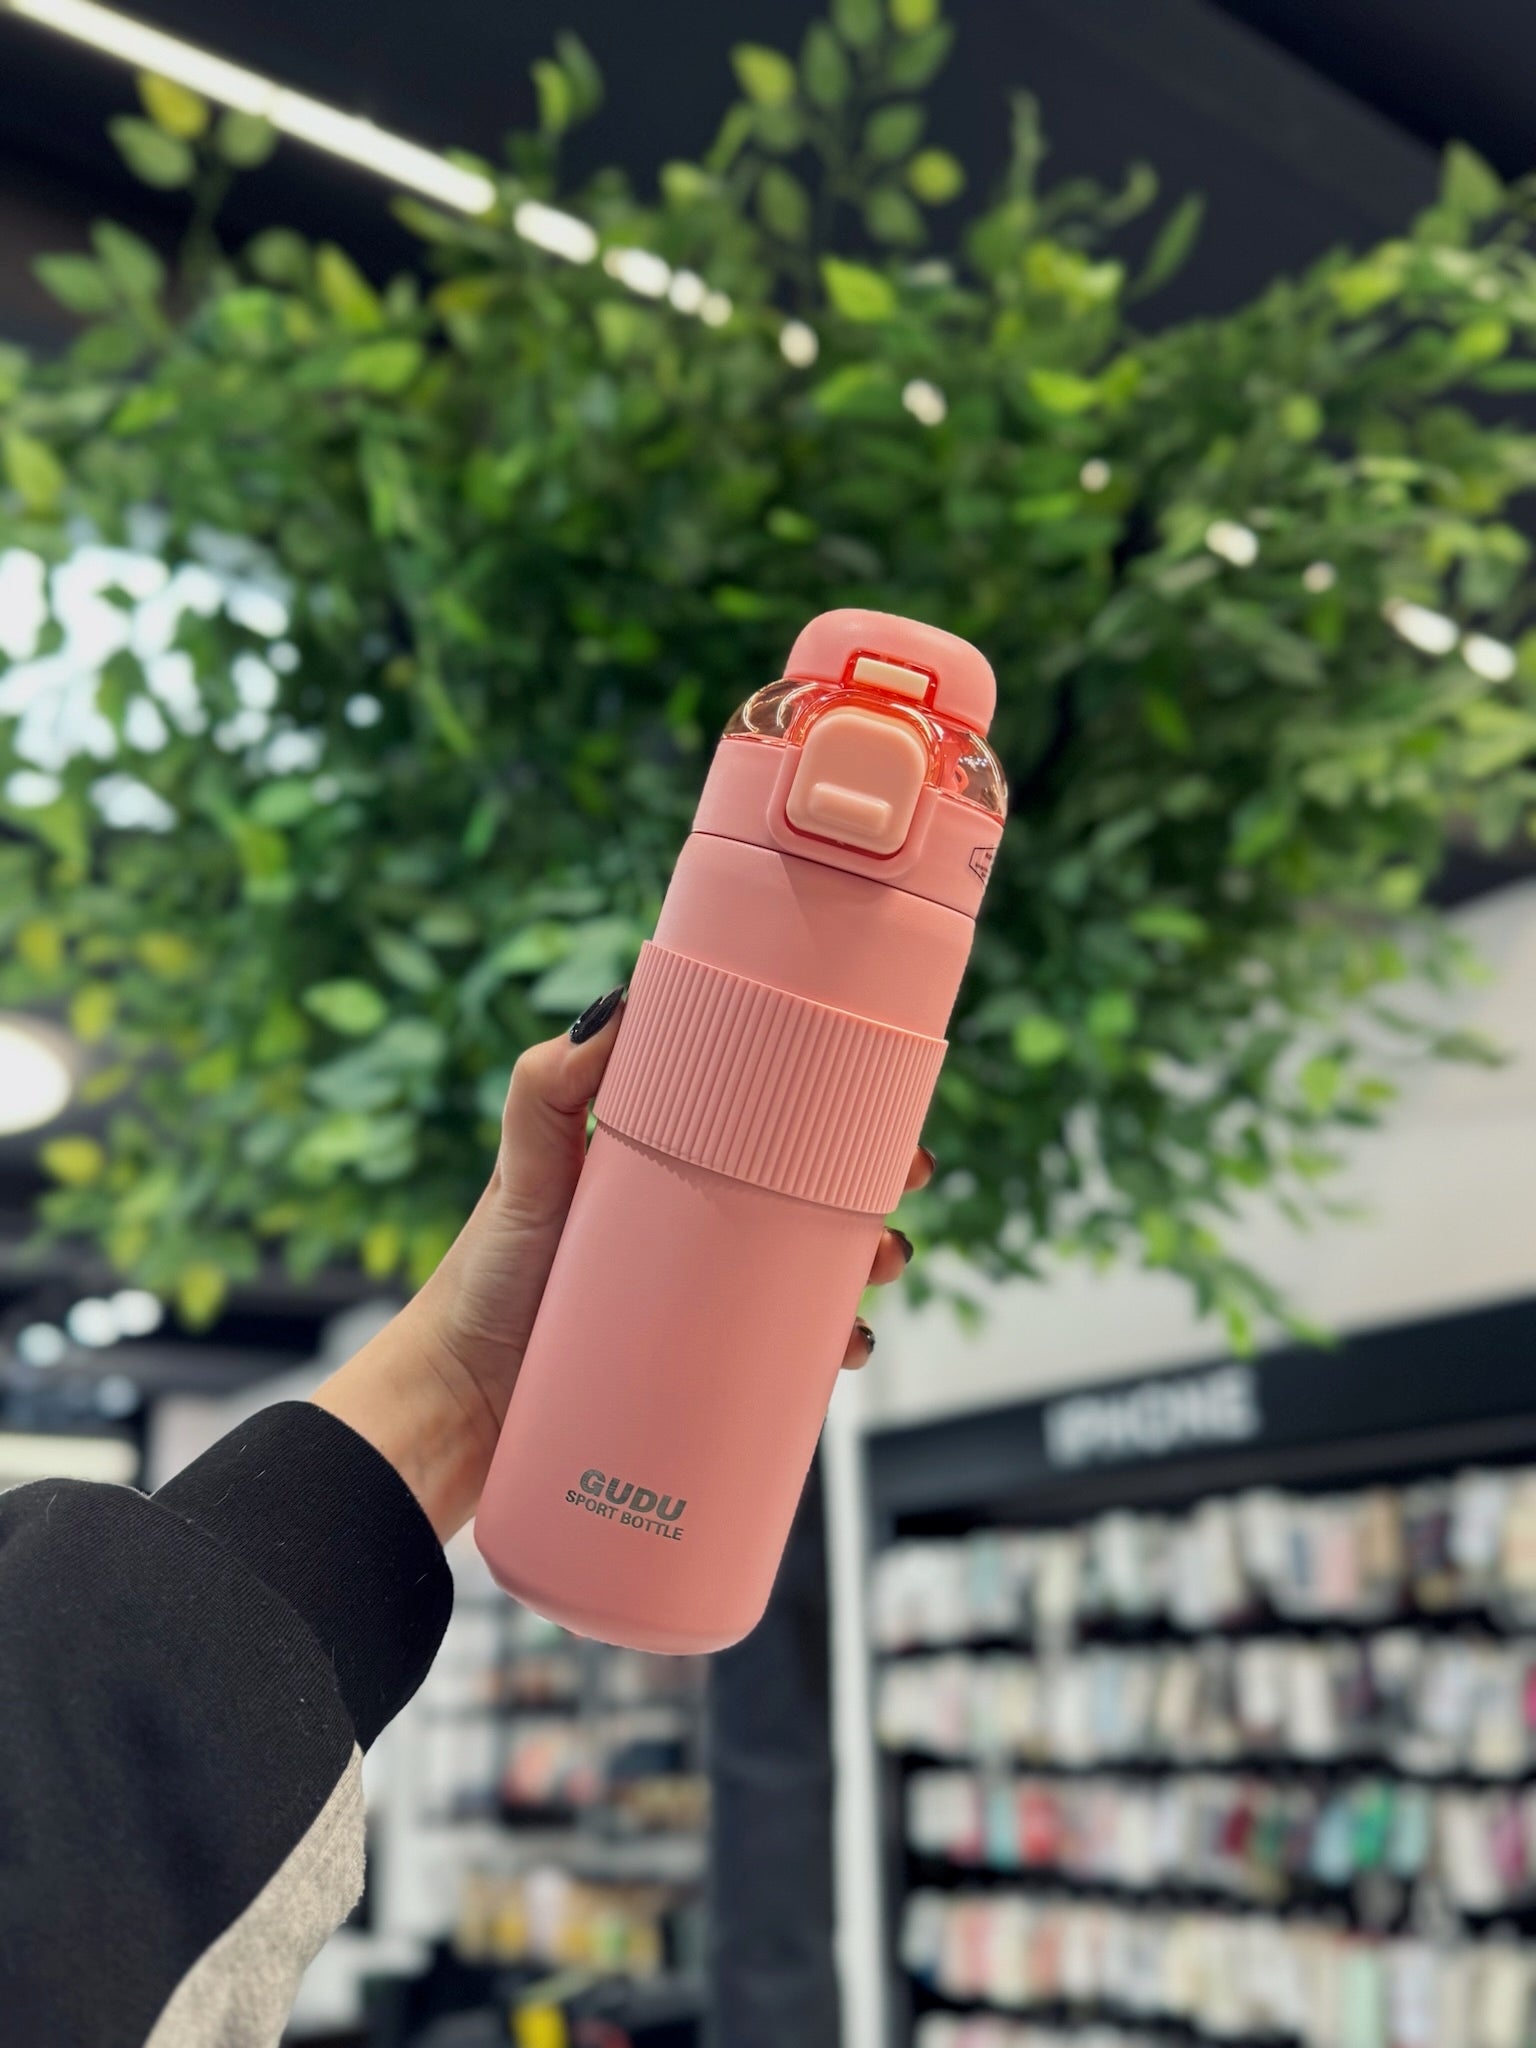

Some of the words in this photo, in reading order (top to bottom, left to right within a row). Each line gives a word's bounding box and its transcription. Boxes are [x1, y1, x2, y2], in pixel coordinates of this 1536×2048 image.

[1045, 1366, 1259, 1467] IPHONE
[565, 1490, 618, 1519] SPORT
[620, 1511, 684, 1540] BOTTLE
[579, 1469, 687, 1521] GUDU
